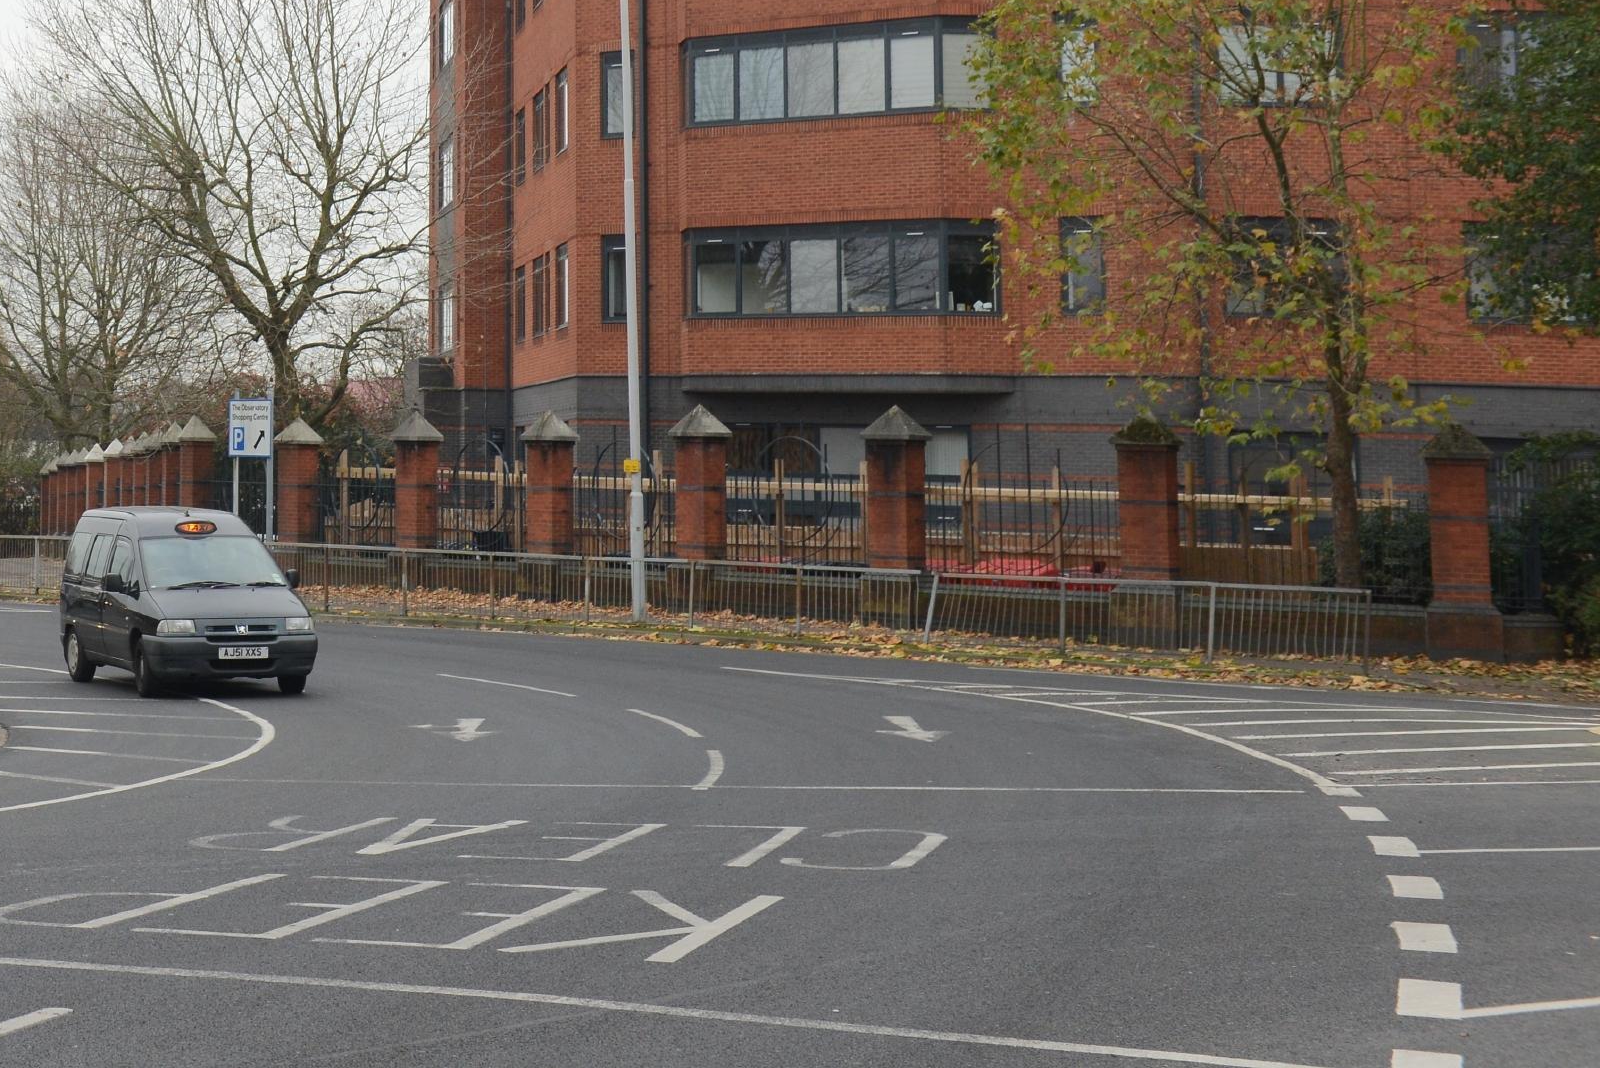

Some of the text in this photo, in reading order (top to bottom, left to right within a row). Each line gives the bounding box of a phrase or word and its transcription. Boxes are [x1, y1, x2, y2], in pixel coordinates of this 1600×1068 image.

[242, 404, 269, 412] Observatory
[232, 414, 253, 422] Shopping
[234, 428, 243, 449] P
[223, 648, 262, 657] AJ51 XXS
[188, 814, 948, 870] CLEAR
